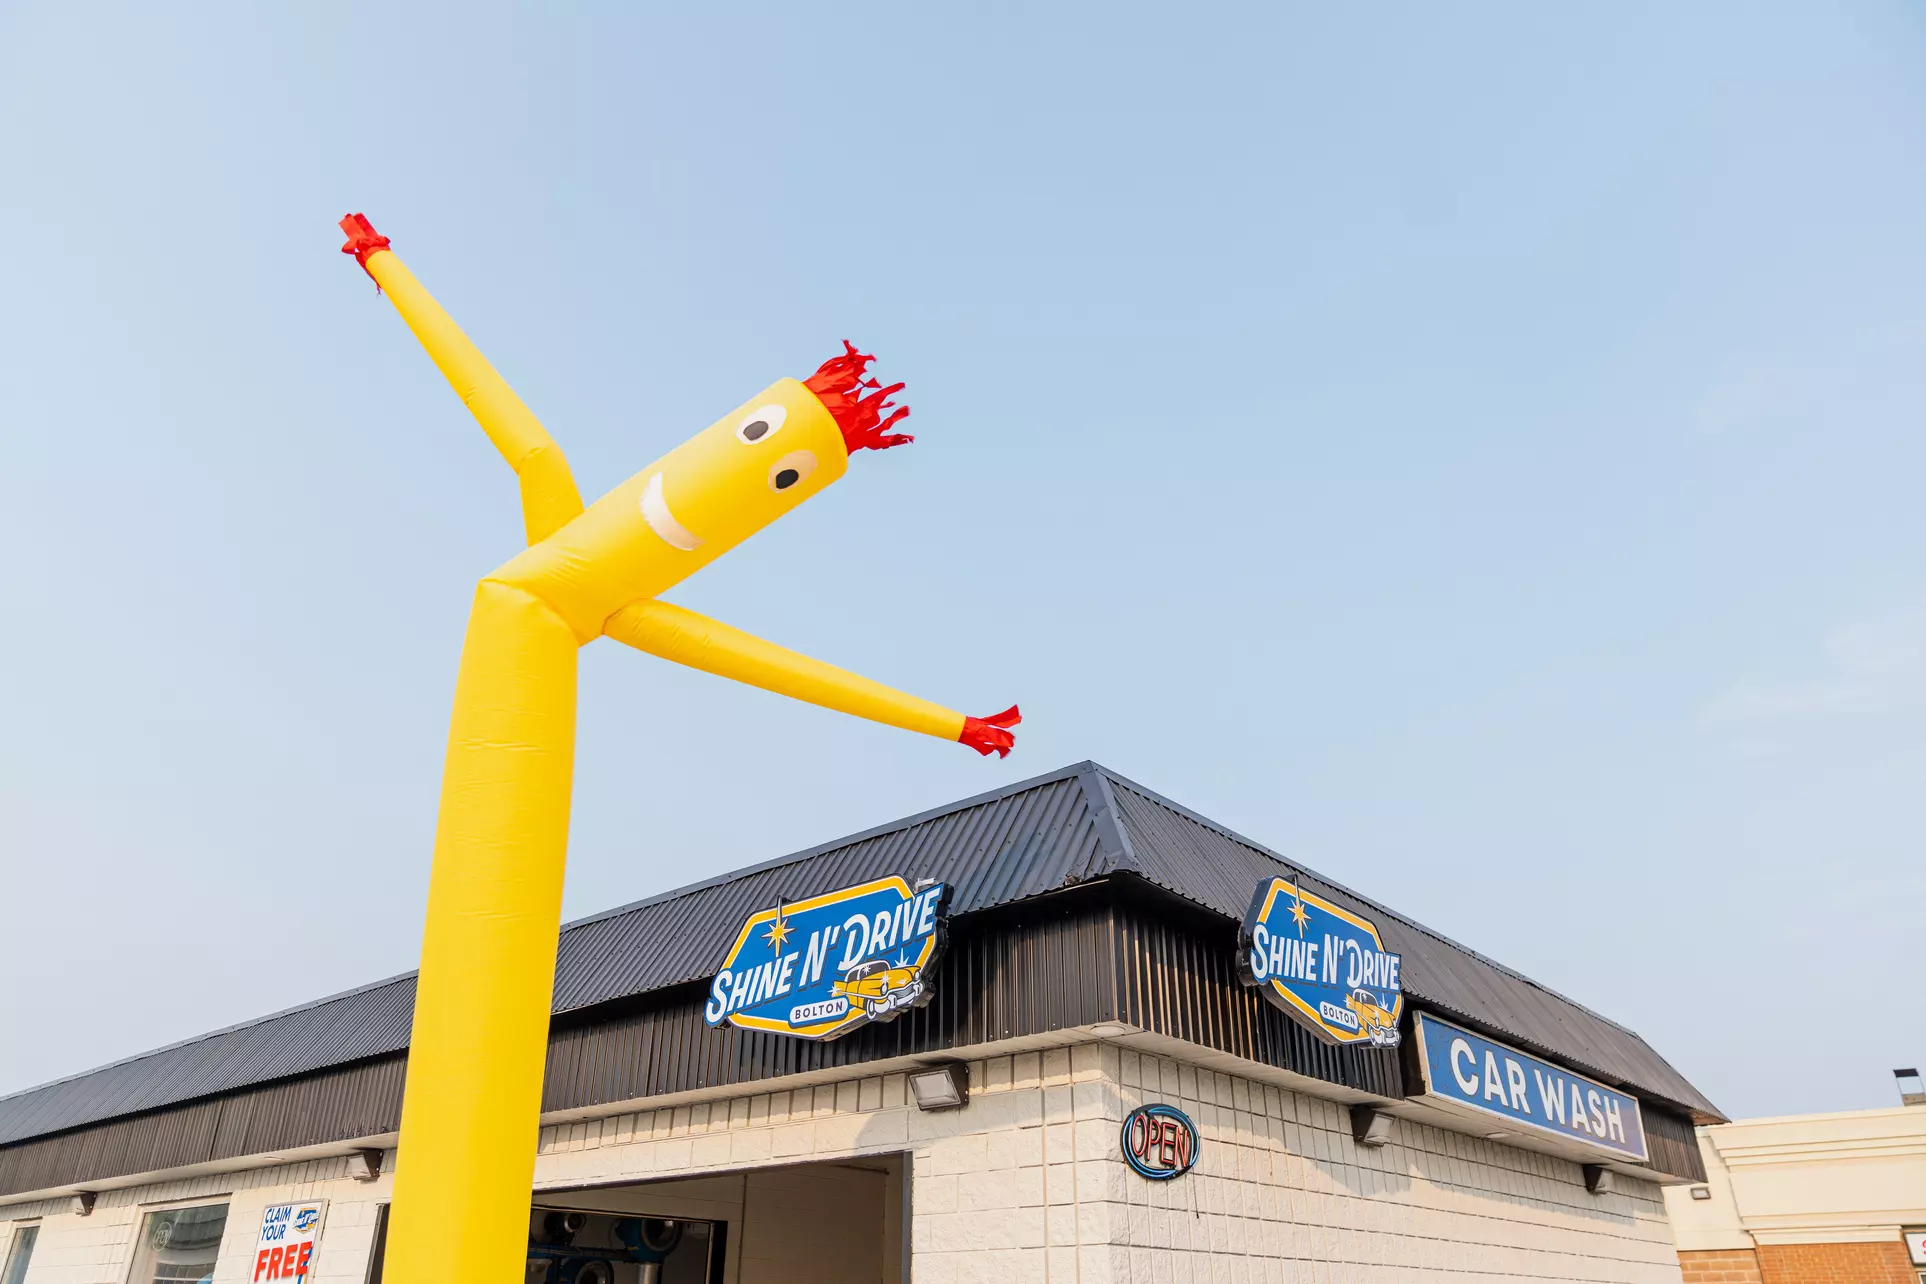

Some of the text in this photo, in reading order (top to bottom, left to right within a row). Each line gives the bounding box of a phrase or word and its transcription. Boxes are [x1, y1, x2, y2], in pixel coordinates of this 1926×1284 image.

[1251, 924, 1319, 980] SHINE
[706, 951, 798, 1023] SHINE
[794, 1001, 843, 1020] BOLTON
[1323, 1005, 1356, 1026] BOLTON
[1450, 1038, 1626, 1144] CAR WASH
[1132, 1115, 1189, 1167] OPEN
[261, 1224, 286, 1241] YOUR
[265, 1206, 292, 1223] CLAIM
[254, 1241, 312, 1282] FREE
